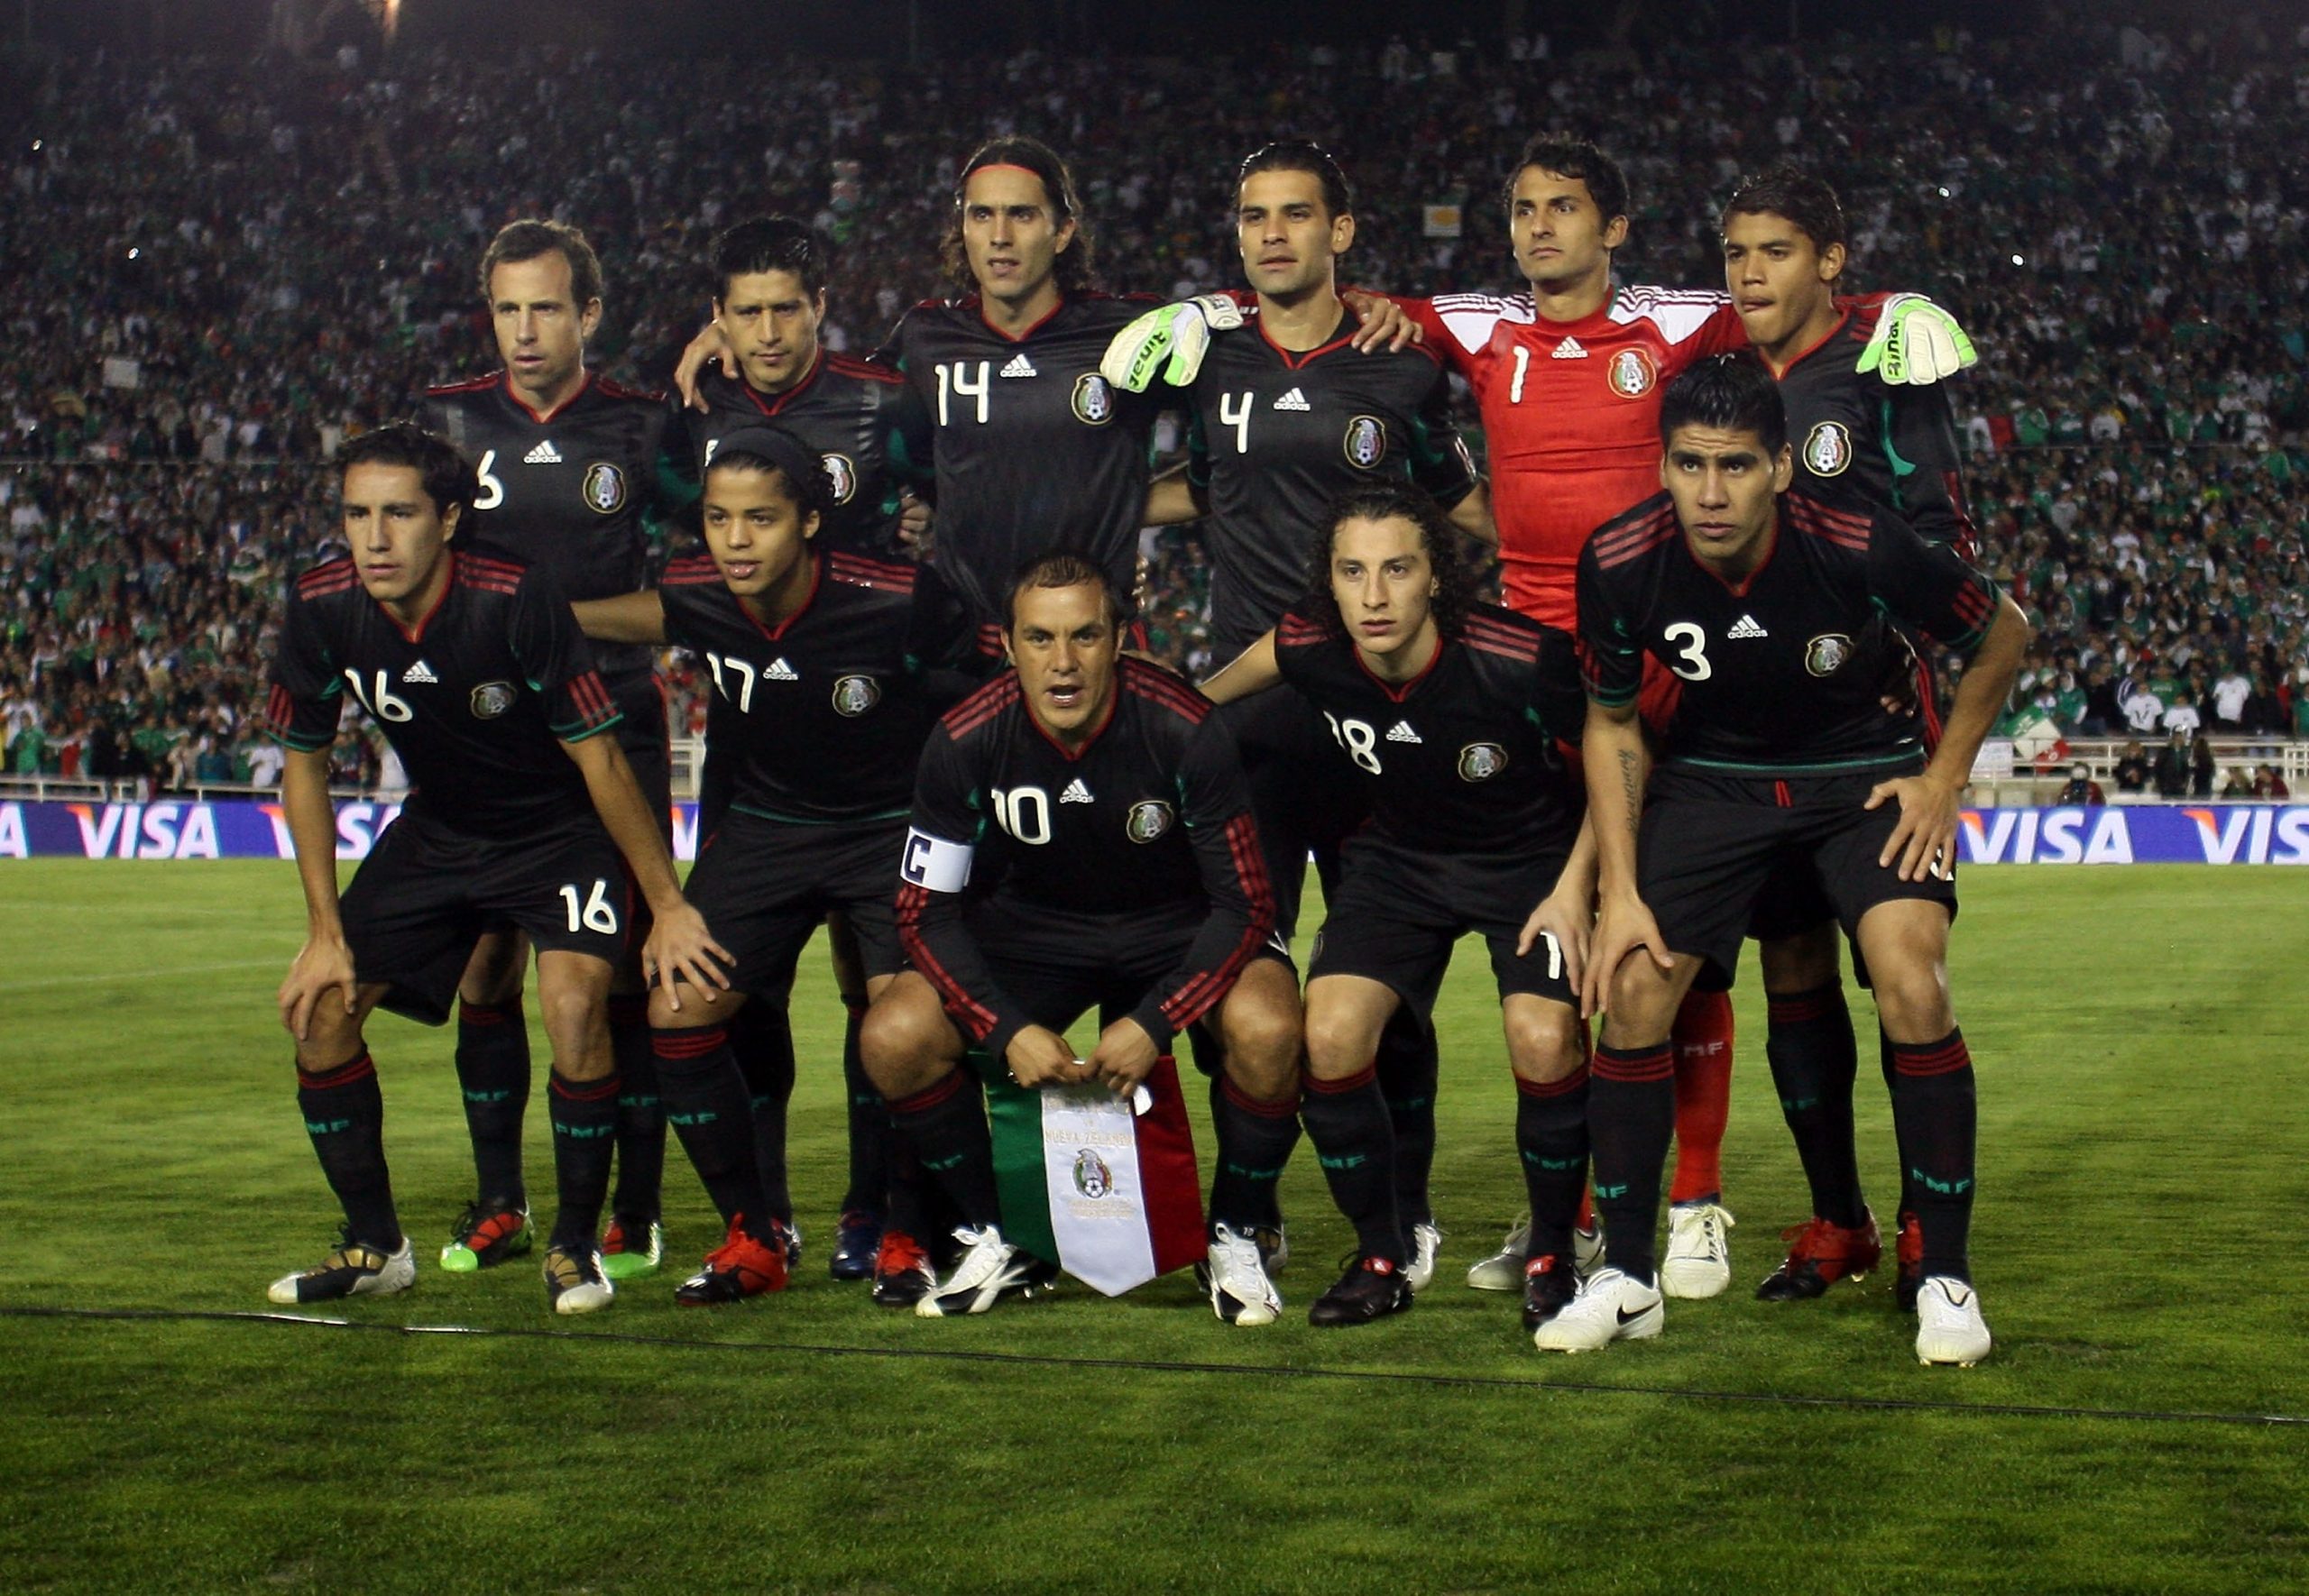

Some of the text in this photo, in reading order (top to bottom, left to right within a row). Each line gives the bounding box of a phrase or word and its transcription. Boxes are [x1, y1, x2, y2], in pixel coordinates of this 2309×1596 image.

[934, 362, 990, 427] 14
[1510, 345, 1531, 404] 1
[1219, 391, 1255, 454] 4
[473, 449, 504, 510] 6
[1664, 621, 1713, 682] 3
[345, 669, 413, 722] 16
[706, 652, 755, 714] 17
[1322, 710, 1383, 775] 18
[66, 803, 220, 859] VISA
[991, 787, 1051, 845] 10
[1959, 810, 2134, 864] VISA
[2183, 809, 2309, 865] VIS
[904, 835, 930, 883] C
[559, 878, 618, 935] 16
[1684, 1041, 1725, 1057] MF
[307, 1119, 350, 1134] MF
